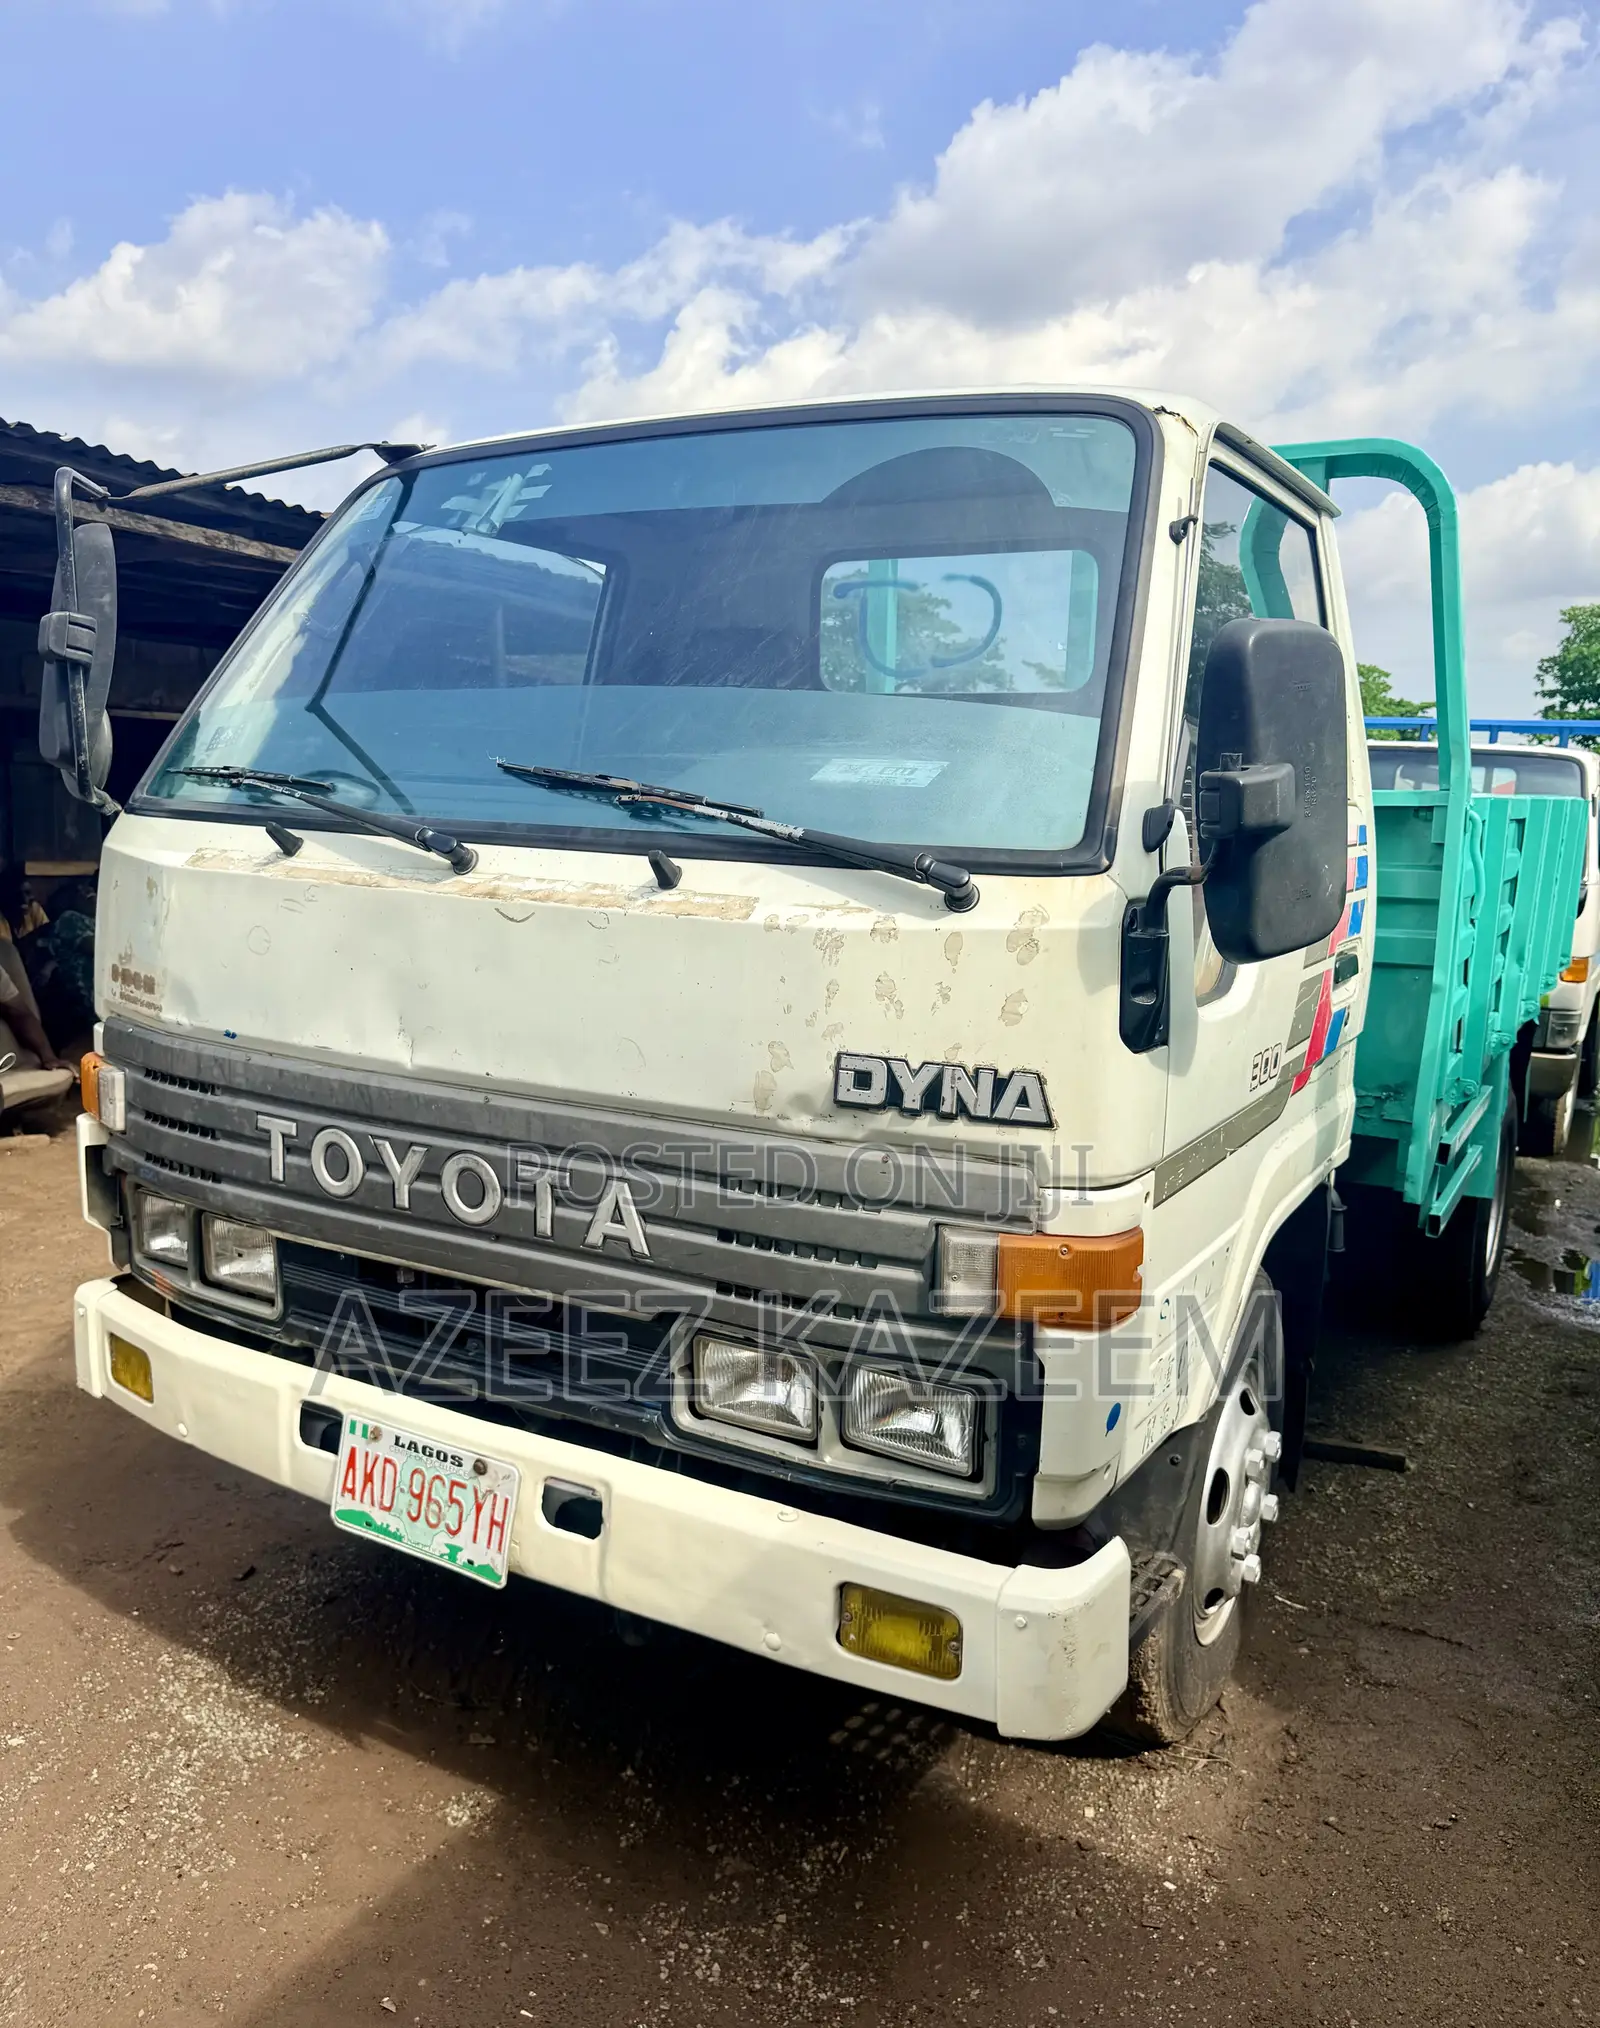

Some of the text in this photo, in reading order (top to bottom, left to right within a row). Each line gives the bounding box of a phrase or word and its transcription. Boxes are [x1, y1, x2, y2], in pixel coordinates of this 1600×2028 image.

[834, 1052, 1057, 1129] DYNA
[1249, 1042, 1282, 1092] 300
[256, 1112, 652, 1259] TOYOTA
[394, 1435, 463, 1468] LAGOS
[426, 1458, 469, 1478] EXCELLENCE
